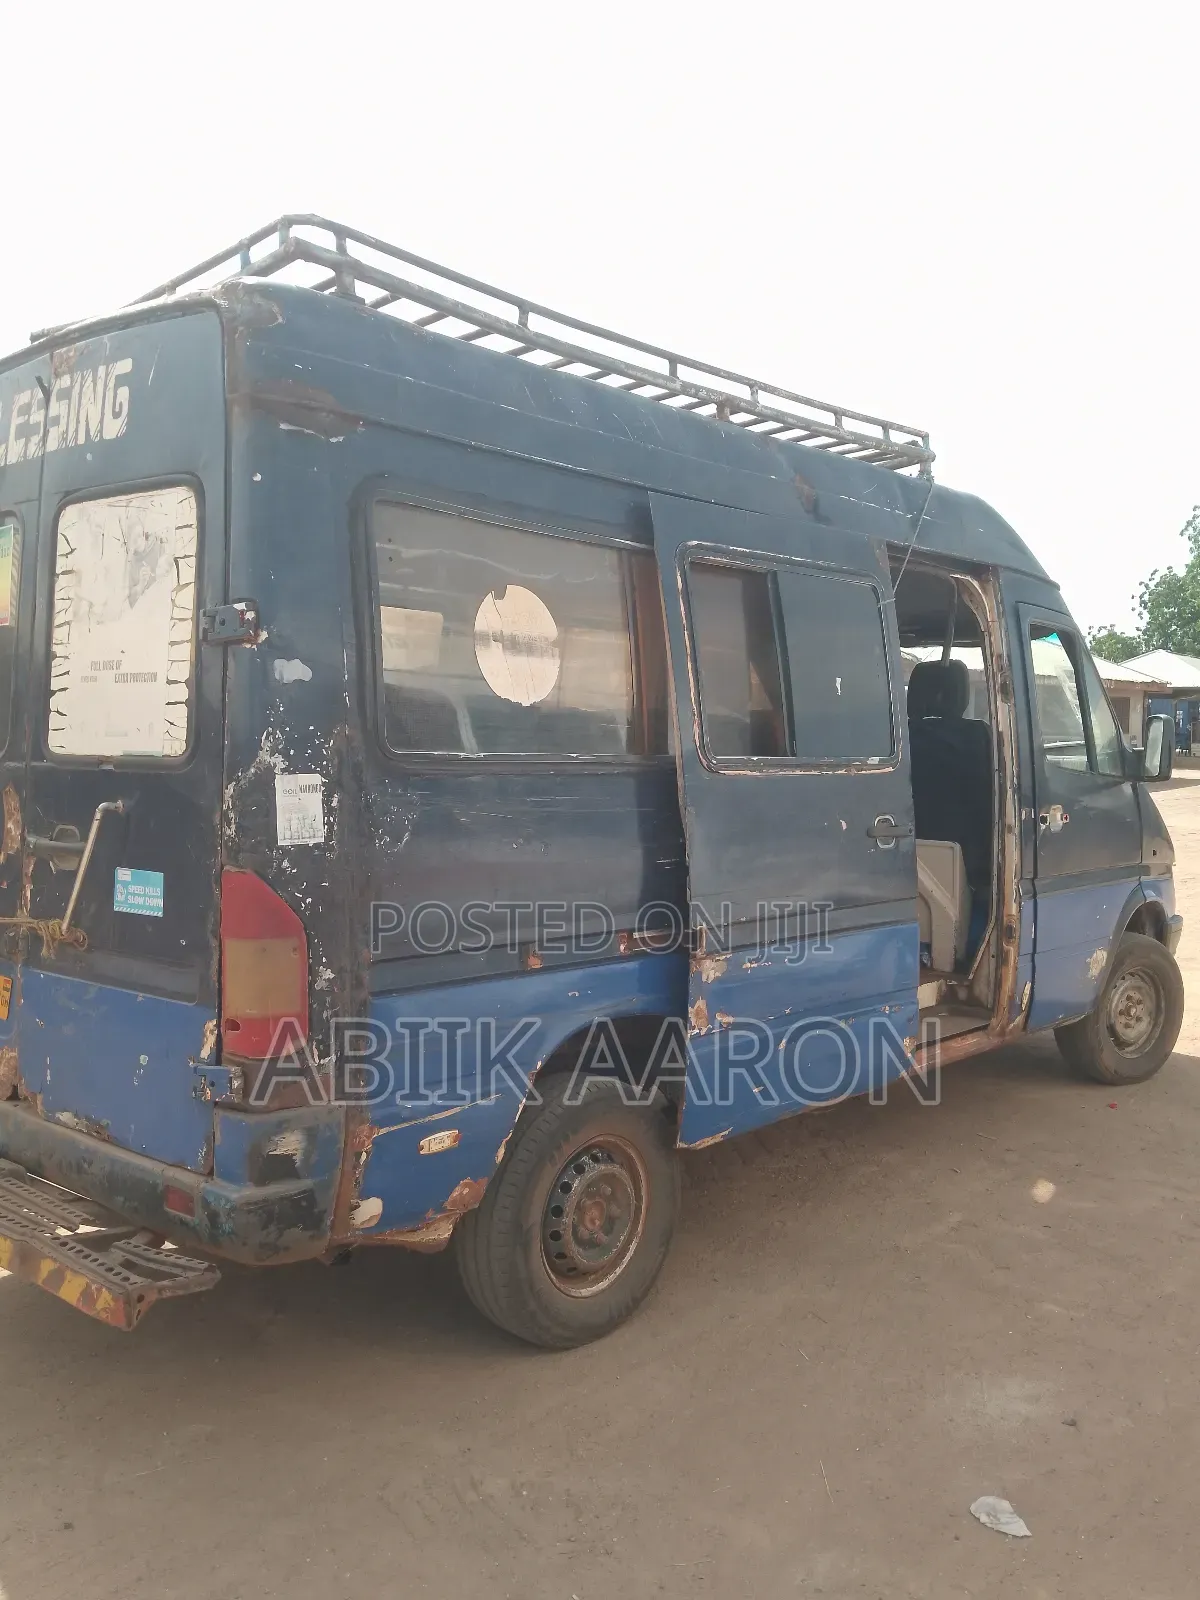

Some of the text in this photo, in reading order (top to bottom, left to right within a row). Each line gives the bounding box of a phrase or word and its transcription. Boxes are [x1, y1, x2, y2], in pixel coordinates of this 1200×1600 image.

[127, 884, 160, 896] SPEED KILLS
[127, 895, 144, 905] SLOW
